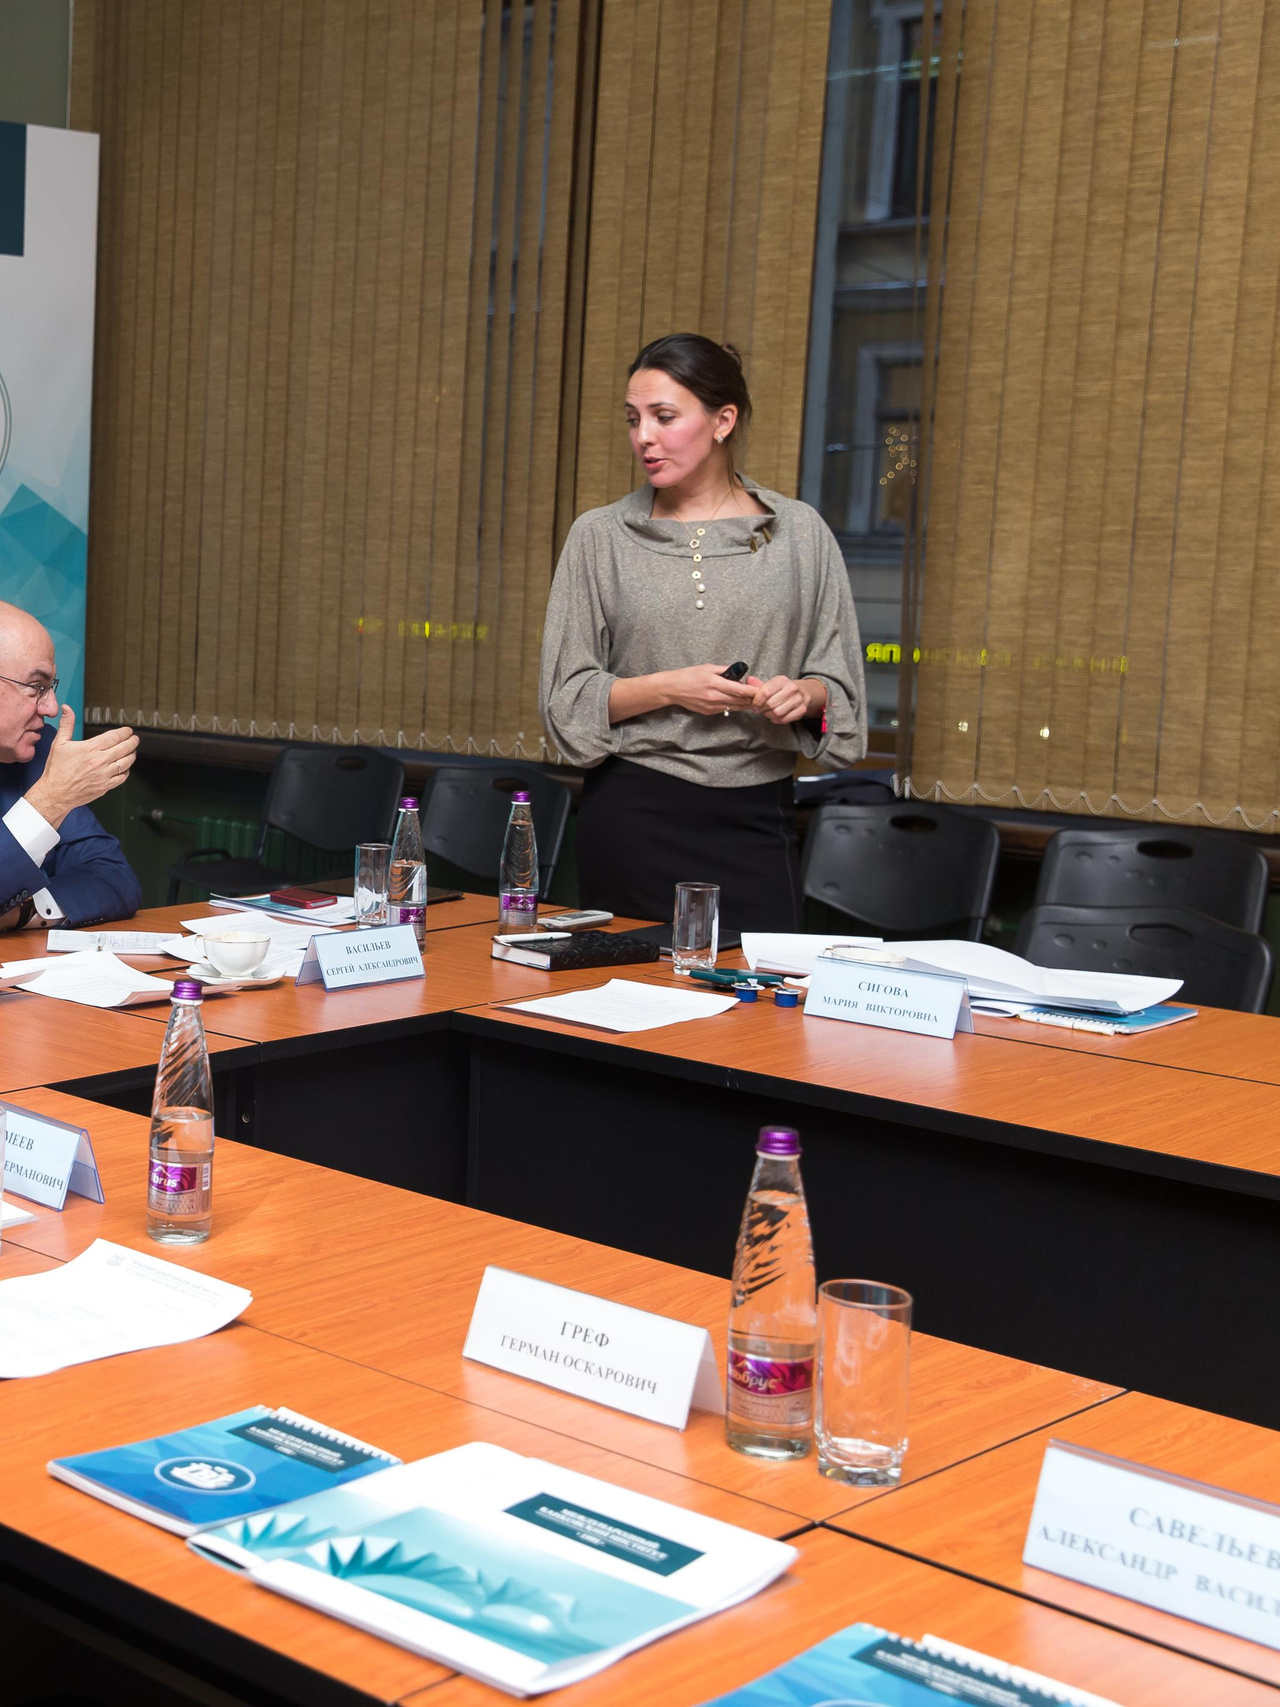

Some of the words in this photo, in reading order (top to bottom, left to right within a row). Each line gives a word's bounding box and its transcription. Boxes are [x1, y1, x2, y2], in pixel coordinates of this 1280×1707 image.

[345, 941, 391, 955] ВАСИЛЬЕВ
[326, 963, 355, 976] СЕРГЕЙ
[358, 956, 419, 972] АЛЕКСАНДРОВИЧ
[858, 981, 909, 998] СИГОВА
[821, 995, 858, 1008] МАРИЯ
[865, 1003, 938, 1023] ВИКТОРОВНА
[560, 1321, 609, 1348] ГРЕФ
[500, 1335, 559, 1364] ГЕРМАН
[563, 1354, 658, 1395] ОСКАРОВИЧ
[1037, 1526, 1178, 1581] АЛЕКСАНДР
